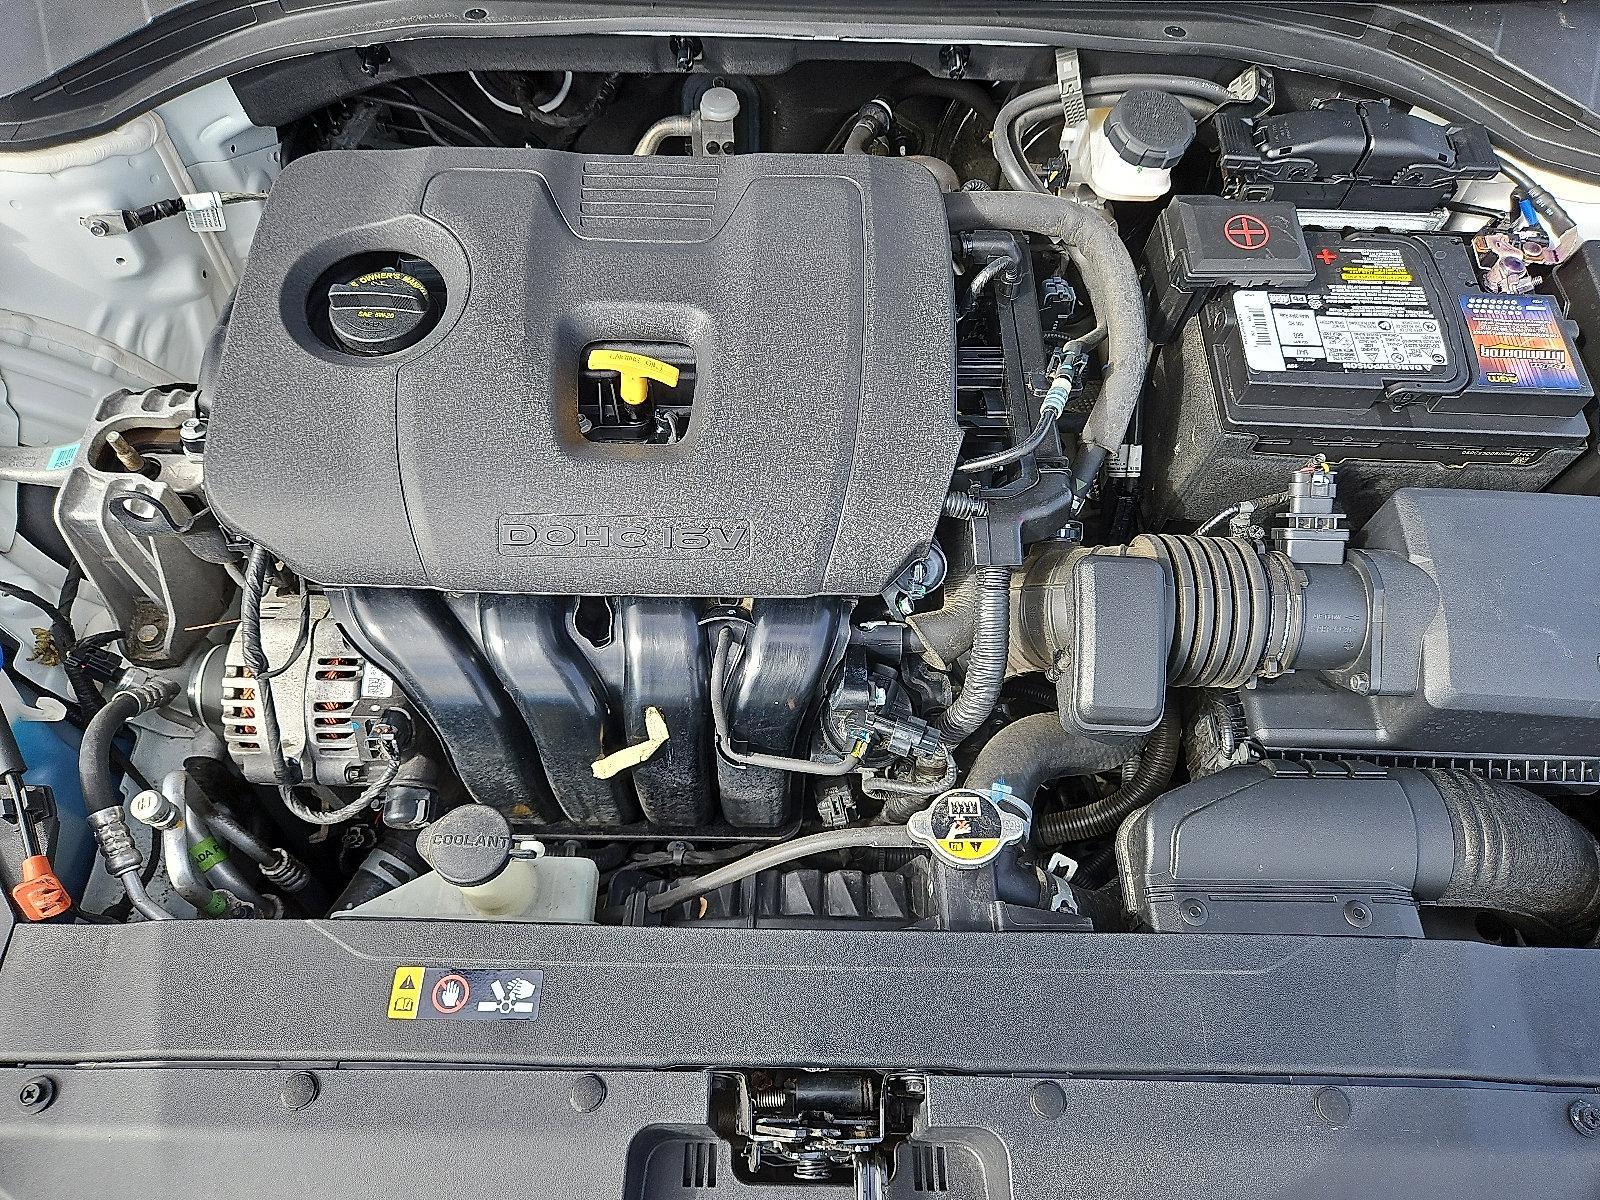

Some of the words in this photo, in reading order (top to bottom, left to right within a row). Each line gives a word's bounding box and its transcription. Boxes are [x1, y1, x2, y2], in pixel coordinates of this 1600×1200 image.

[359, 272, 402, 284] OWNER'S
[502, 523, 647, 549] DOHC
[662, 526, 746, 551] 16V
[433, 834, 510, 849] COOLANT
